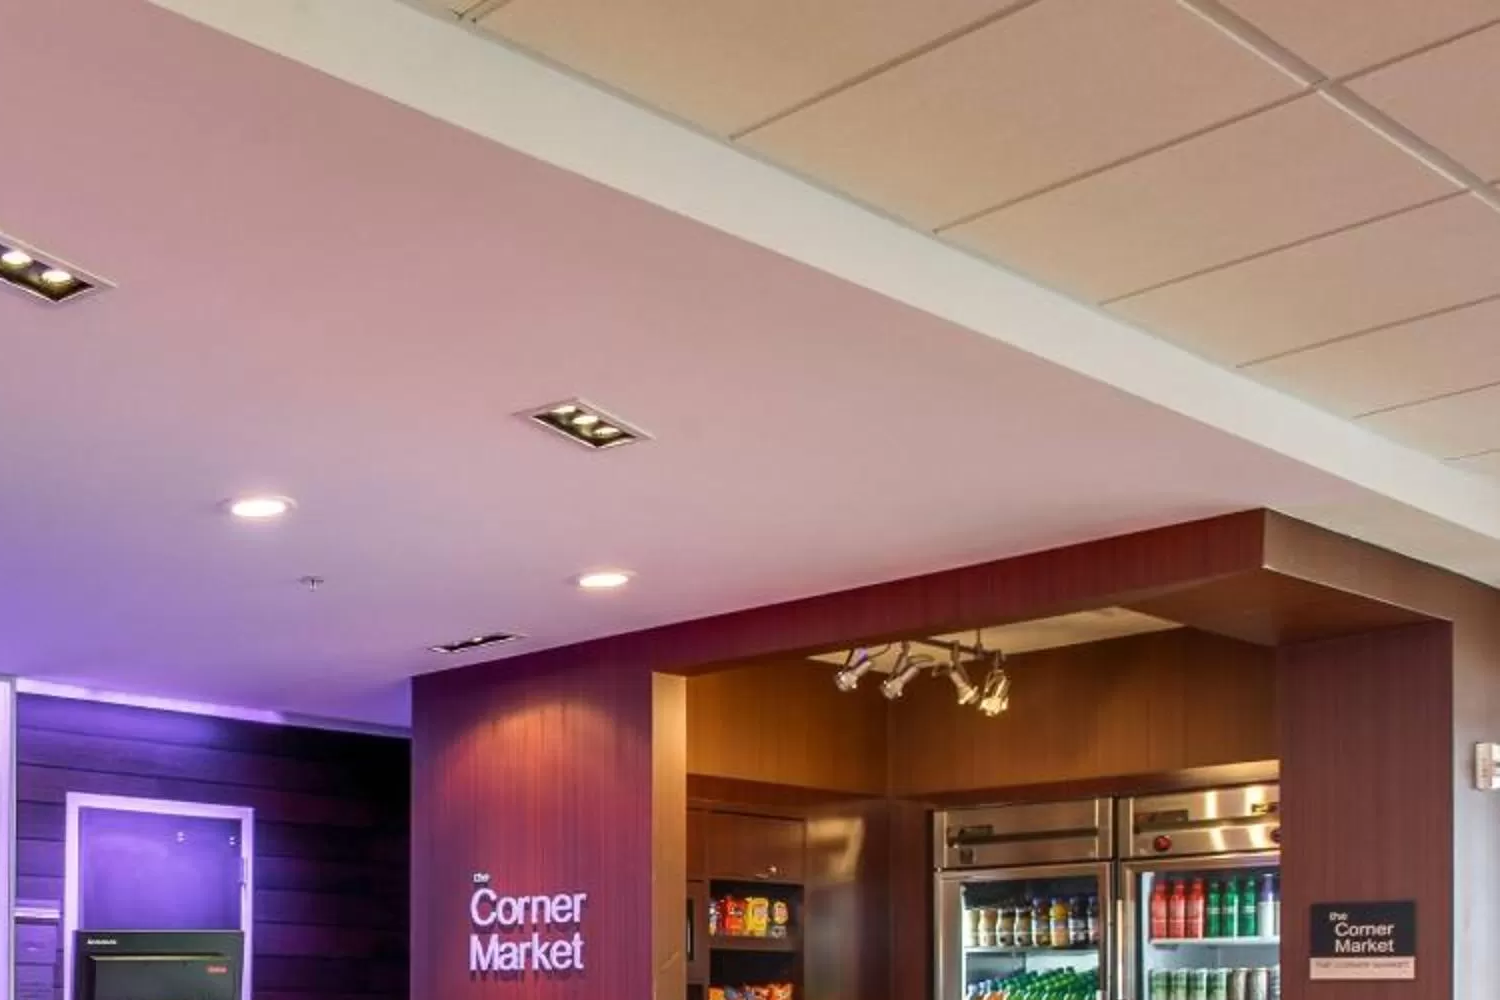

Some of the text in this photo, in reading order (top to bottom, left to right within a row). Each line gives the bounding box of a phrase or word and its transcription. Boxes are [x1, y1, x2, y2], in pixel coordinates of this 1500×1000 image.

[470, 888, 587, 926] Corner
[1328, 911, 1349, 921] the
[1334, 922, 1395, 937] Corner
[469, 932, 584, 971] Market
[1334, 938, 1395, 953] Market
